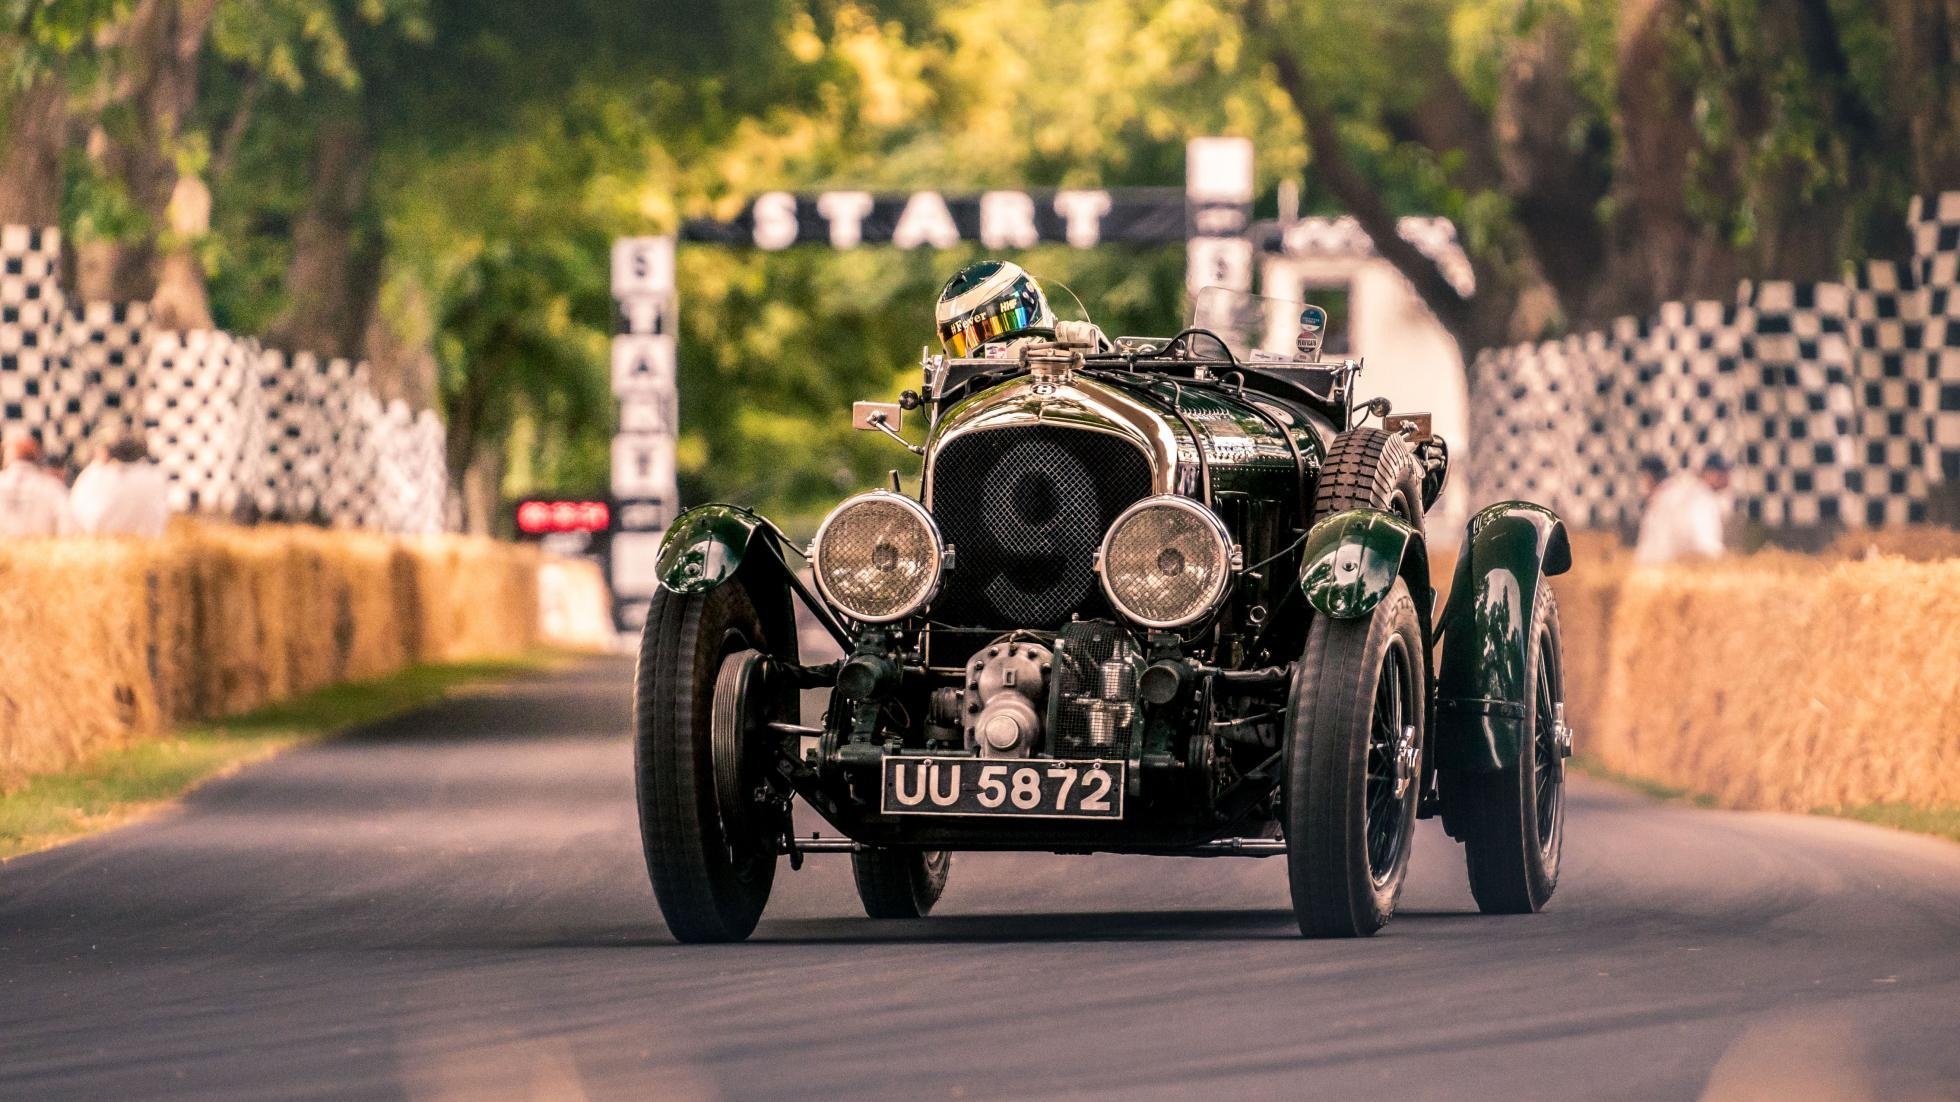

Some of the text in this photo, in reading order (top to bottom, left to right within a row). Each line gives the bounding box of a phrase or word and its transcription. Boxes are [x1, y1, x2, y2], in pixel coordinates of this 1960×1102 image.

[752, 190, 1111, 249] START
[950, 311, 986, 336] #Fever
[983, 441, 1100, 624] 9
[896, 764, 1112, 811] UU 5872
